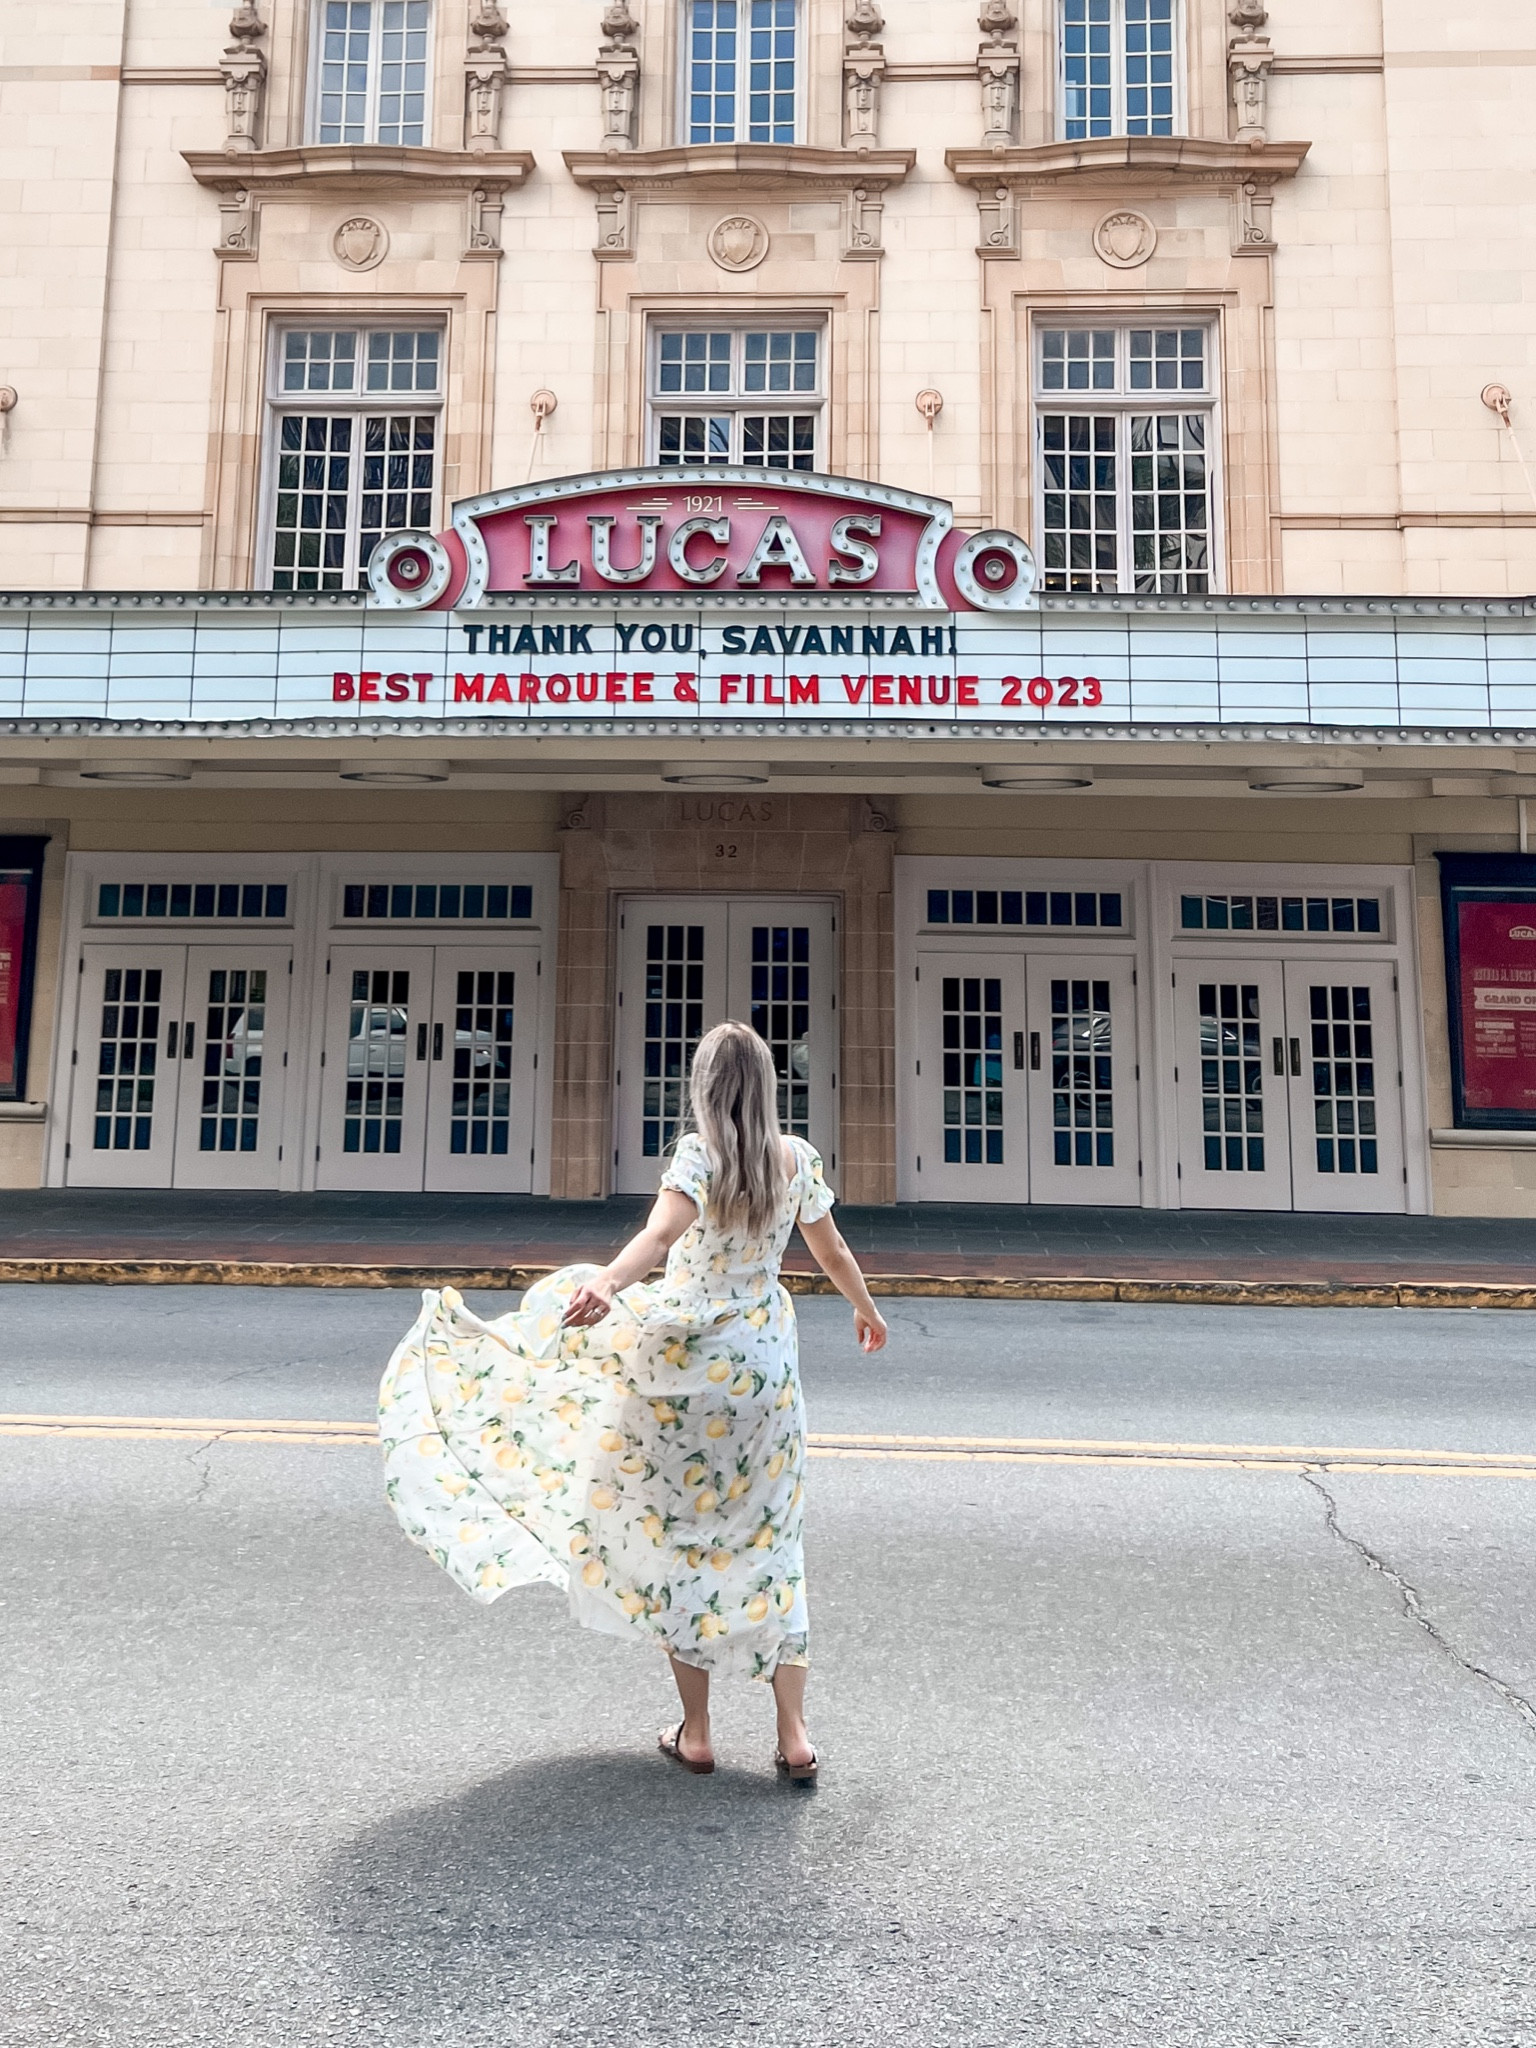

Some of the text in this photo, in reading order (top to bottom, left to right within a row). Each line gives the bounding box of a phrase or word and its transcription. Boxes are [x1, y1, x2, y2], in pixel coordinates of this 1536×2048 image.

[682, 495, 723, 512] 1921
[522, 515, 882, 584] LUCAS
[463, 623, 957, 660] THANK YOU, SAVANNAH!
[332, 672, 1103, 706] BEST MARQUEE & FILM VENUE 2023
[680, 801, 772, 822] LUCAS
[715, 844, 737, 858] 32
[1483, 994, 1522, 1004] GRAND
